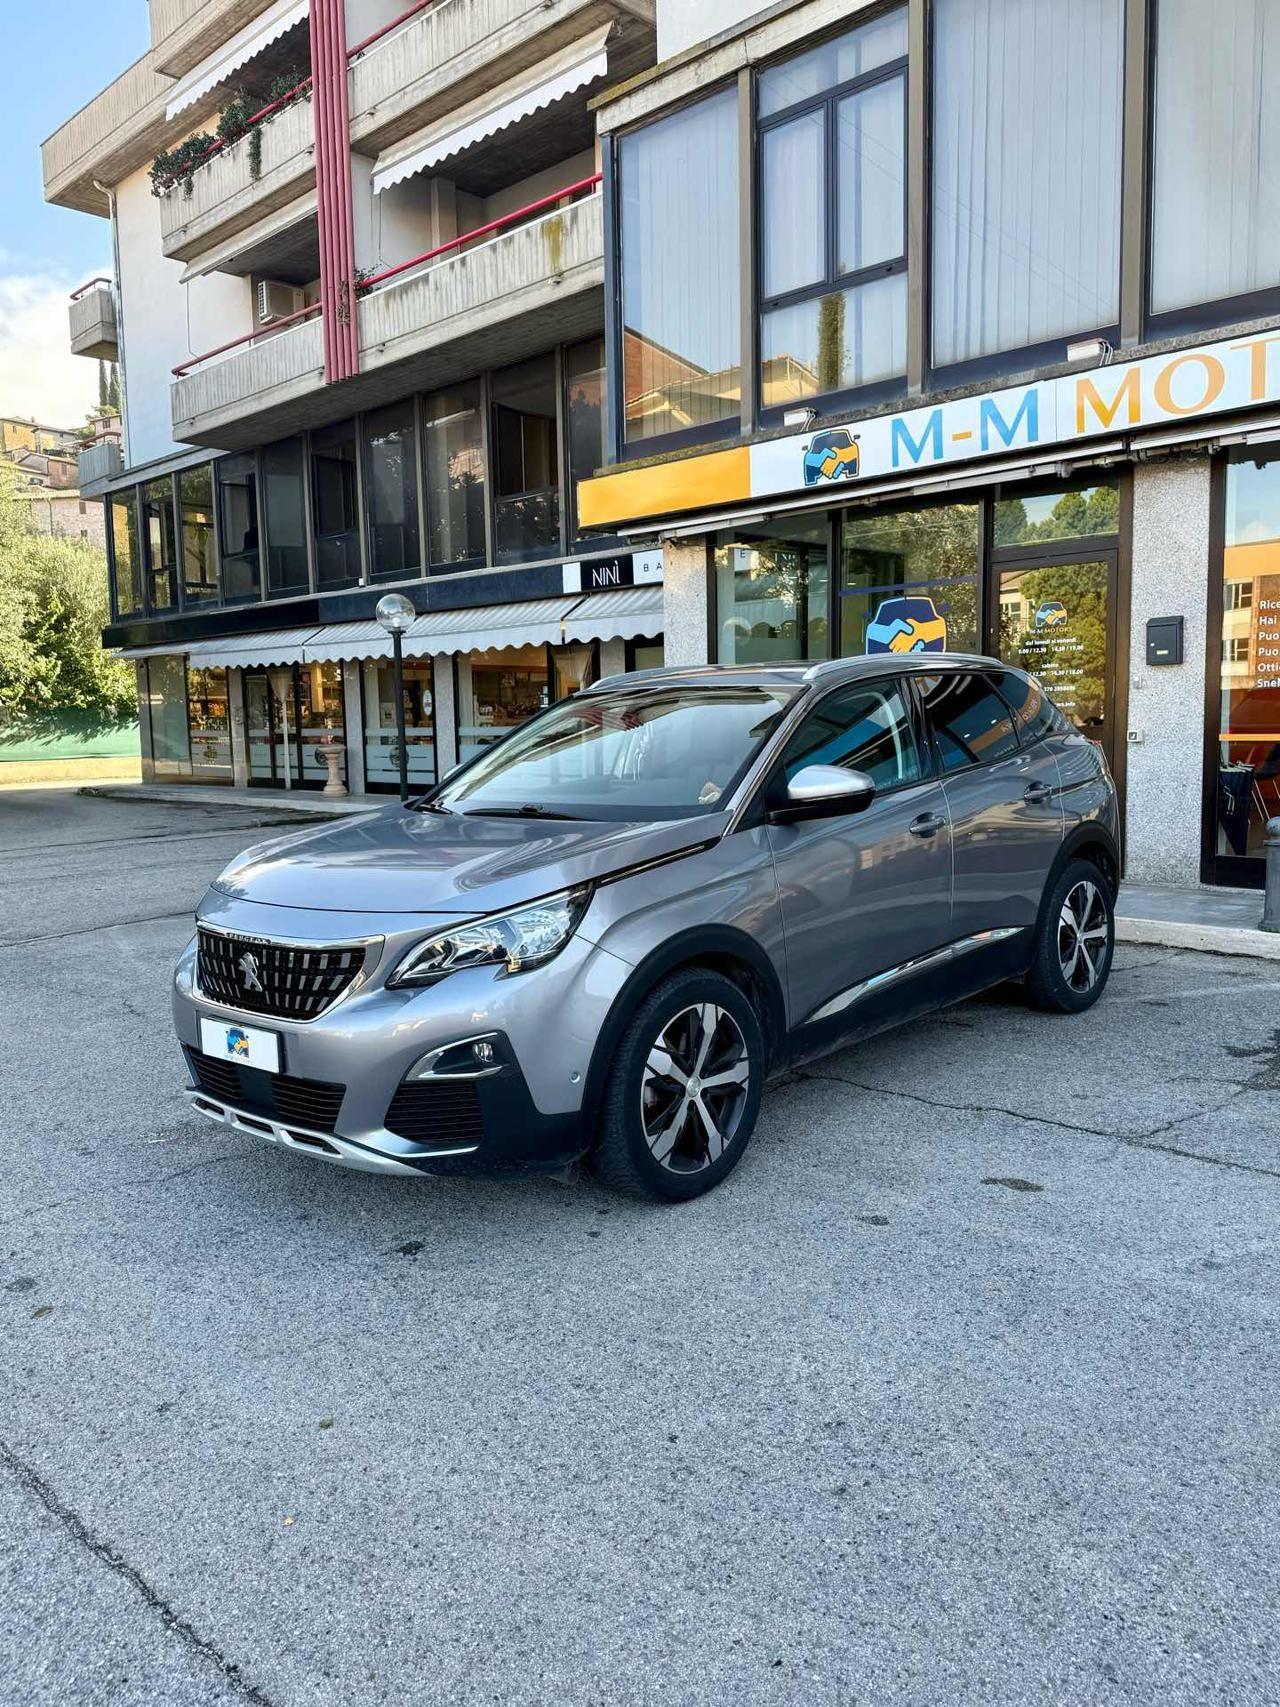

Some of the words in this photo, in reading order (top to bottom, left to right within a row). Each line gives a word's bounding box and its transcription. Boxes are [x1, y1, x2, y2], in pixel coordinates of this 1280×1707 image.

[891, 388, 1039, 468] M-M
[1075, 337, 1280, 434] MOT
[592, 559, 620, 587] NINÌ
[643, 561, 663, 573] BA
[1259, 615, 1278, 625] Hai
[1258, 631, 1280, 641] Puo
[1258, 647, 1280, 657] Puo
[1257, 662, 1280, 672] Otti
